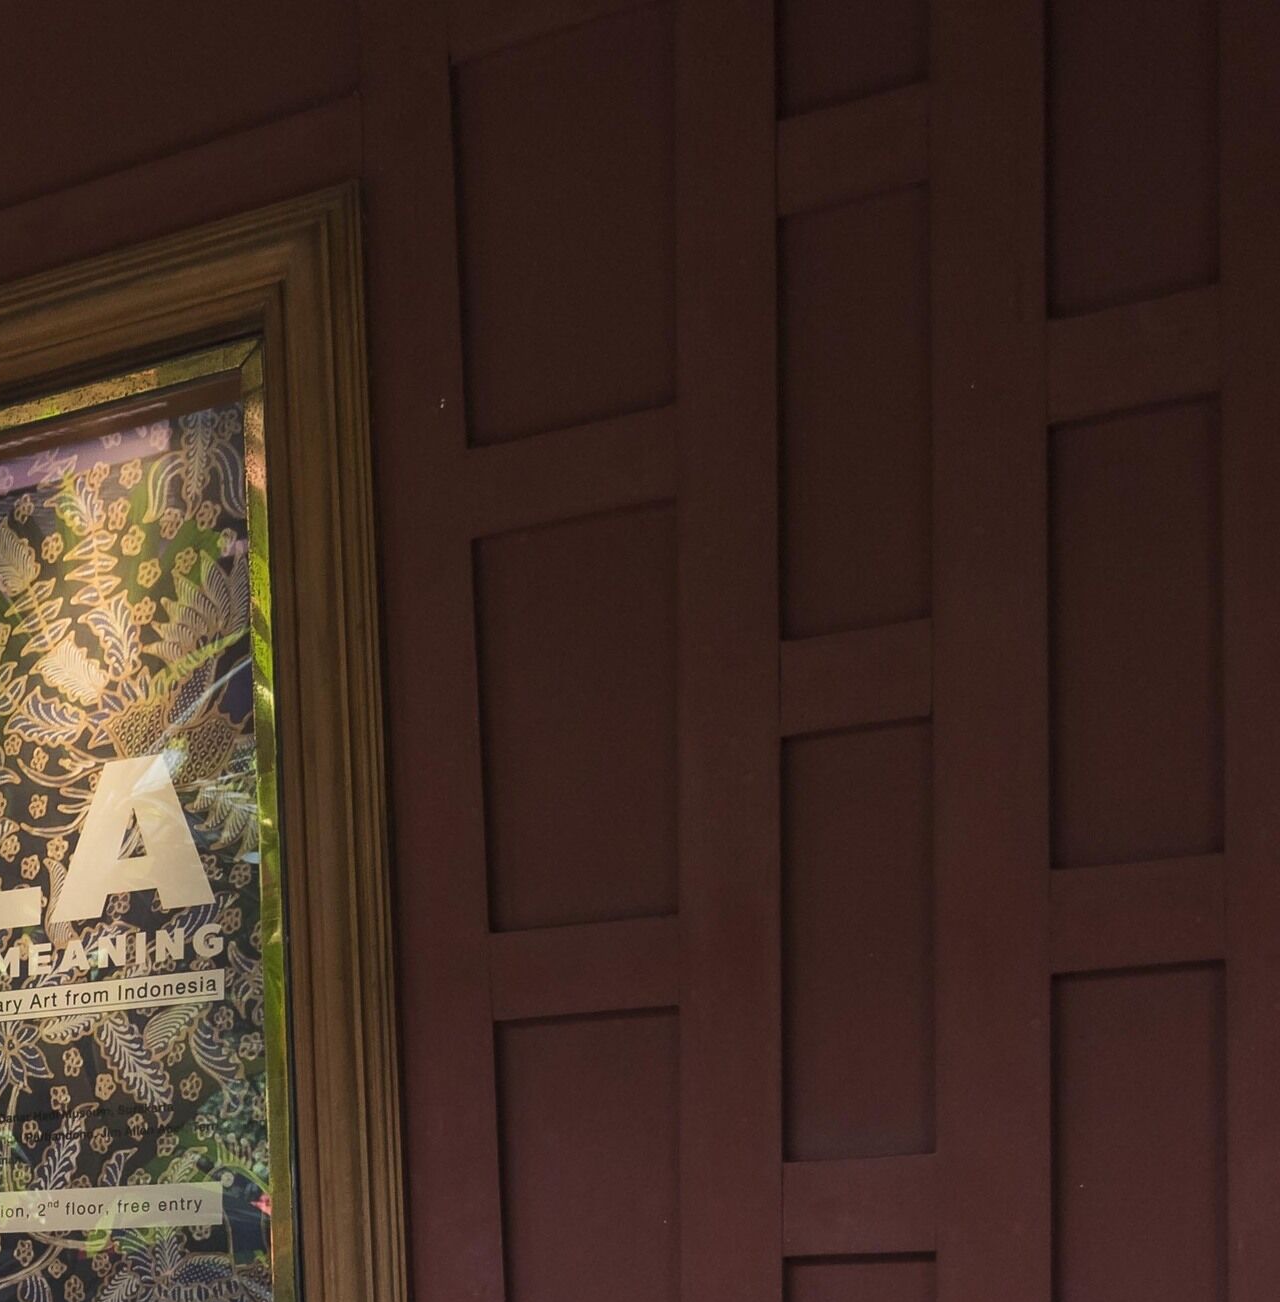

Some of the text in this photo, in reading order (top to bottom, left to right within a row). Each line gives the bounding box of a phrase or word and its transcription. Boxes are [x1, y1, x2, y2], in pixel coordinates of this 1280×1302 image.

[30, 992, 57, 1010] Art
[66, 988, 110, 1006] from
[118, 976, 217, 1001] Indonesia
[38, 1200, 60, 1217] 2nd
[66, 1201, 109, 1217] floor,
[118, 1199, 151, 1213] free
[158, 1198, 202, 1214] entry
